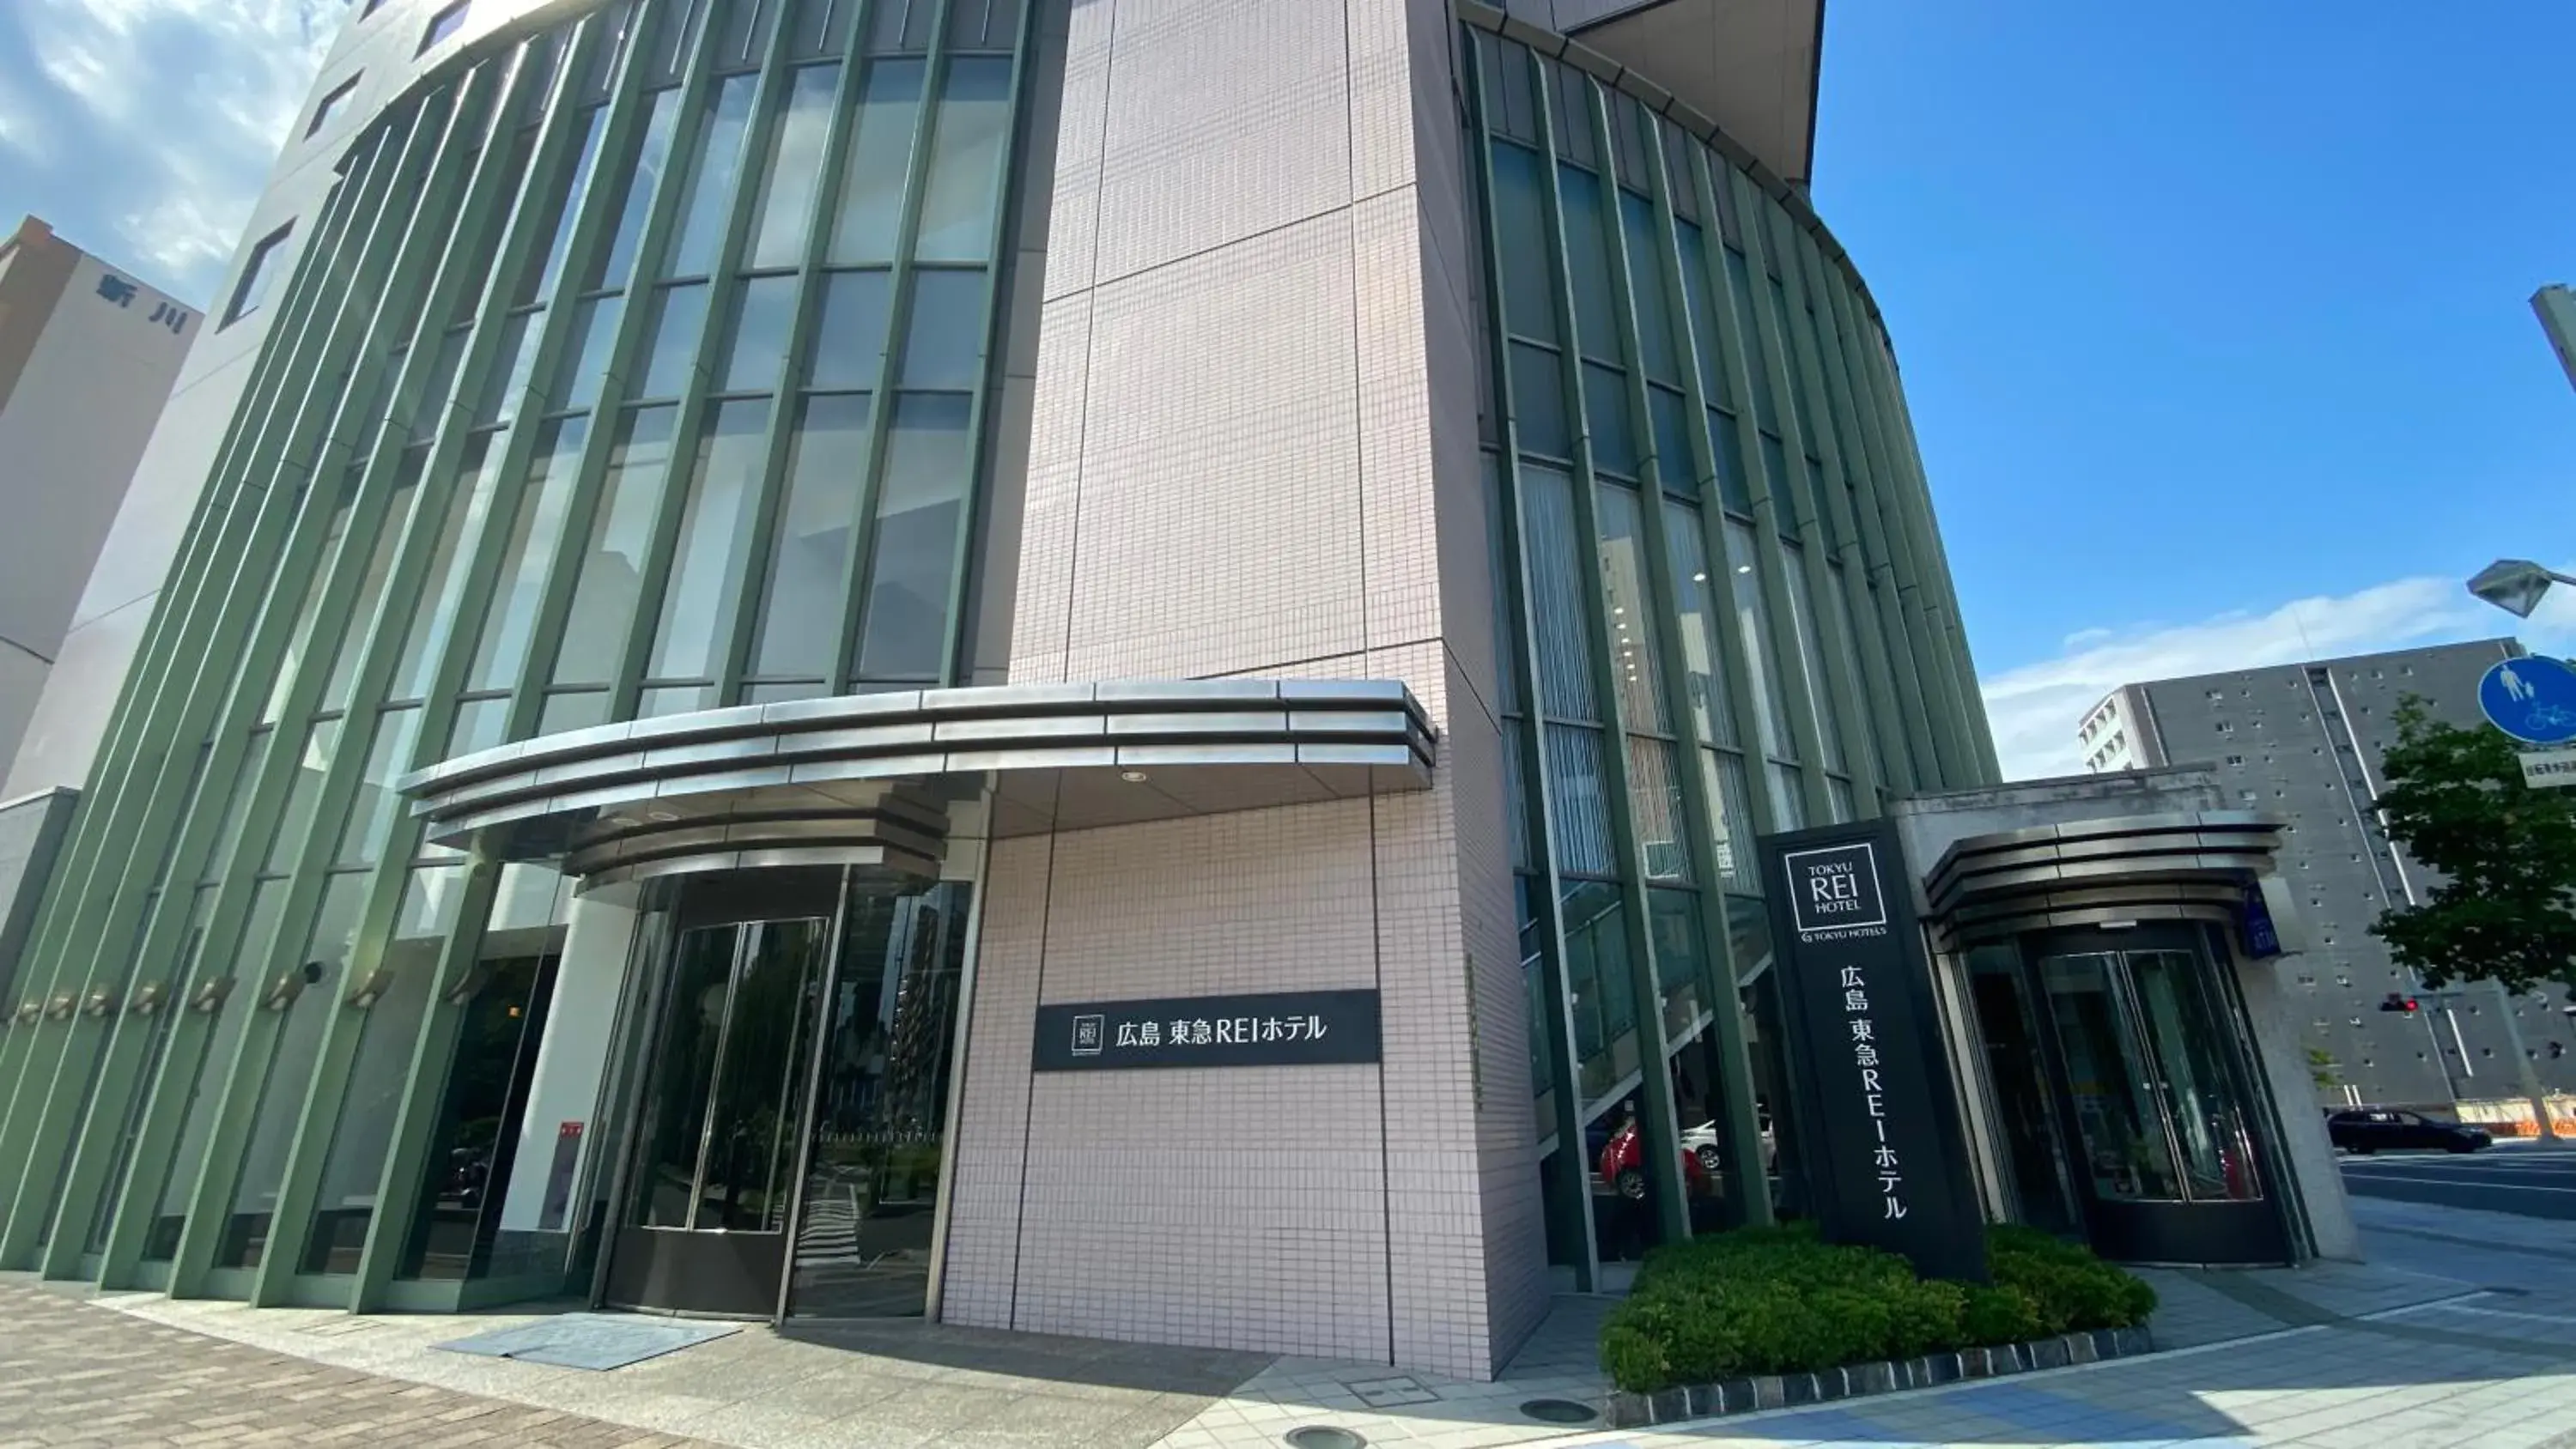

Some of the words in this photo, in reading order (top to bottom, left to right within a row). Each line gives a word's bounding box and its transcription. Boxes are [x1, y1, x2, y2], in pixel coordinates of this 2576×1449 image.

[1807, 861, 1853, 876] TOKYU
[1810, 873, 1859, 901] REI
[1814, 899, 1862, 914] HOTEL
[1814, 929, 1848, 943] TOKYU
[1849, 926, 1887, 938] HOTELS
[1840, 965, 1868, 1012] 広島
[1115, 1020, 1160, 1047] 広島
[1168, 1015, 1328, 1046] 東急REIホテル
[1848, 1018, 1908, 1220] 東急REIホテル
